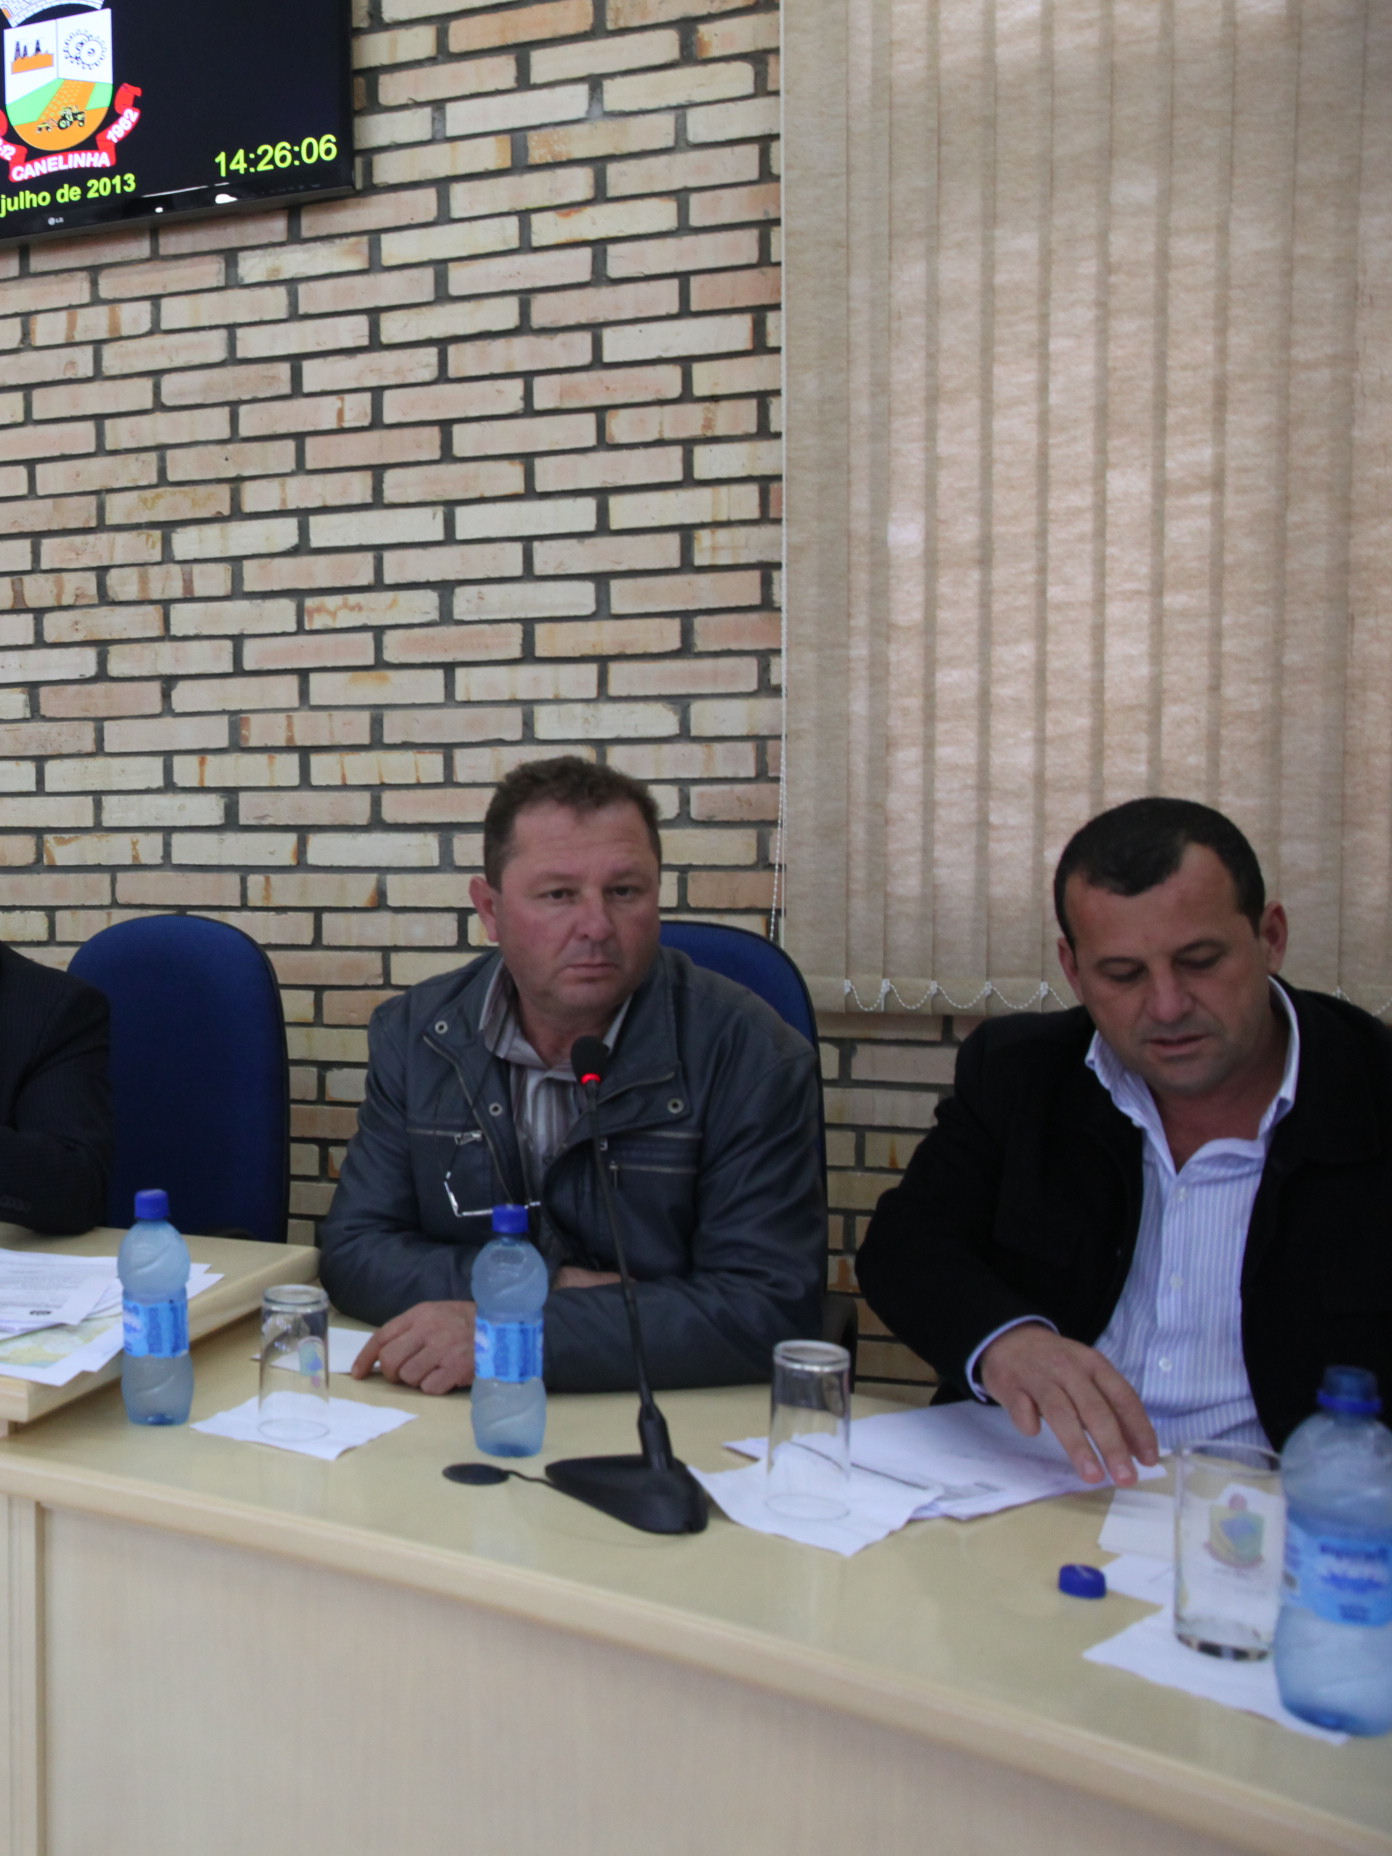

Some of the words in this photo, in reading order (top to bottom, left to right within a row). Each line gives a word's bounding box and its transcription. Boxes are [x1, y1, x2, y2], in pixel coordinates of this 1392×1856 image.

[11, 152, 110, 181] CANELINHA
[214, 133, 338, 177] 14:26:06
[55, 183, 82, 202] de
[86, 172, 136, 199] 2013
